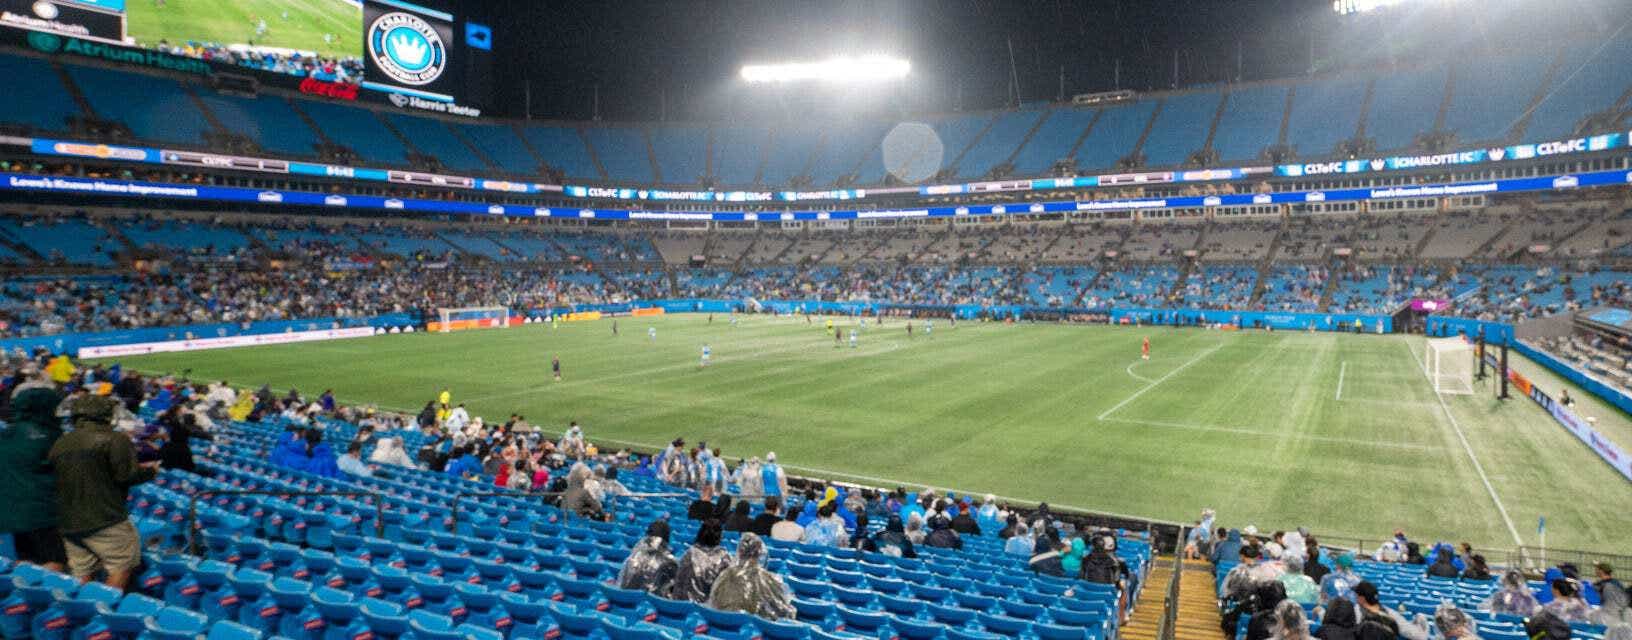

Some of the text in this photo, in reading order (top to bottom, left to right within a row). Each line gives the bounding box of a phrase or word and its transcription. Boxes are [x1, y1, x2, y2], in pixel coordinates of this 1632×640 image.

[379, 15, 440, 41] CHARLOTTE
[64, 37, 211, 75] Atrium Health
[409, 96, 480, 117] Harris Teeter
